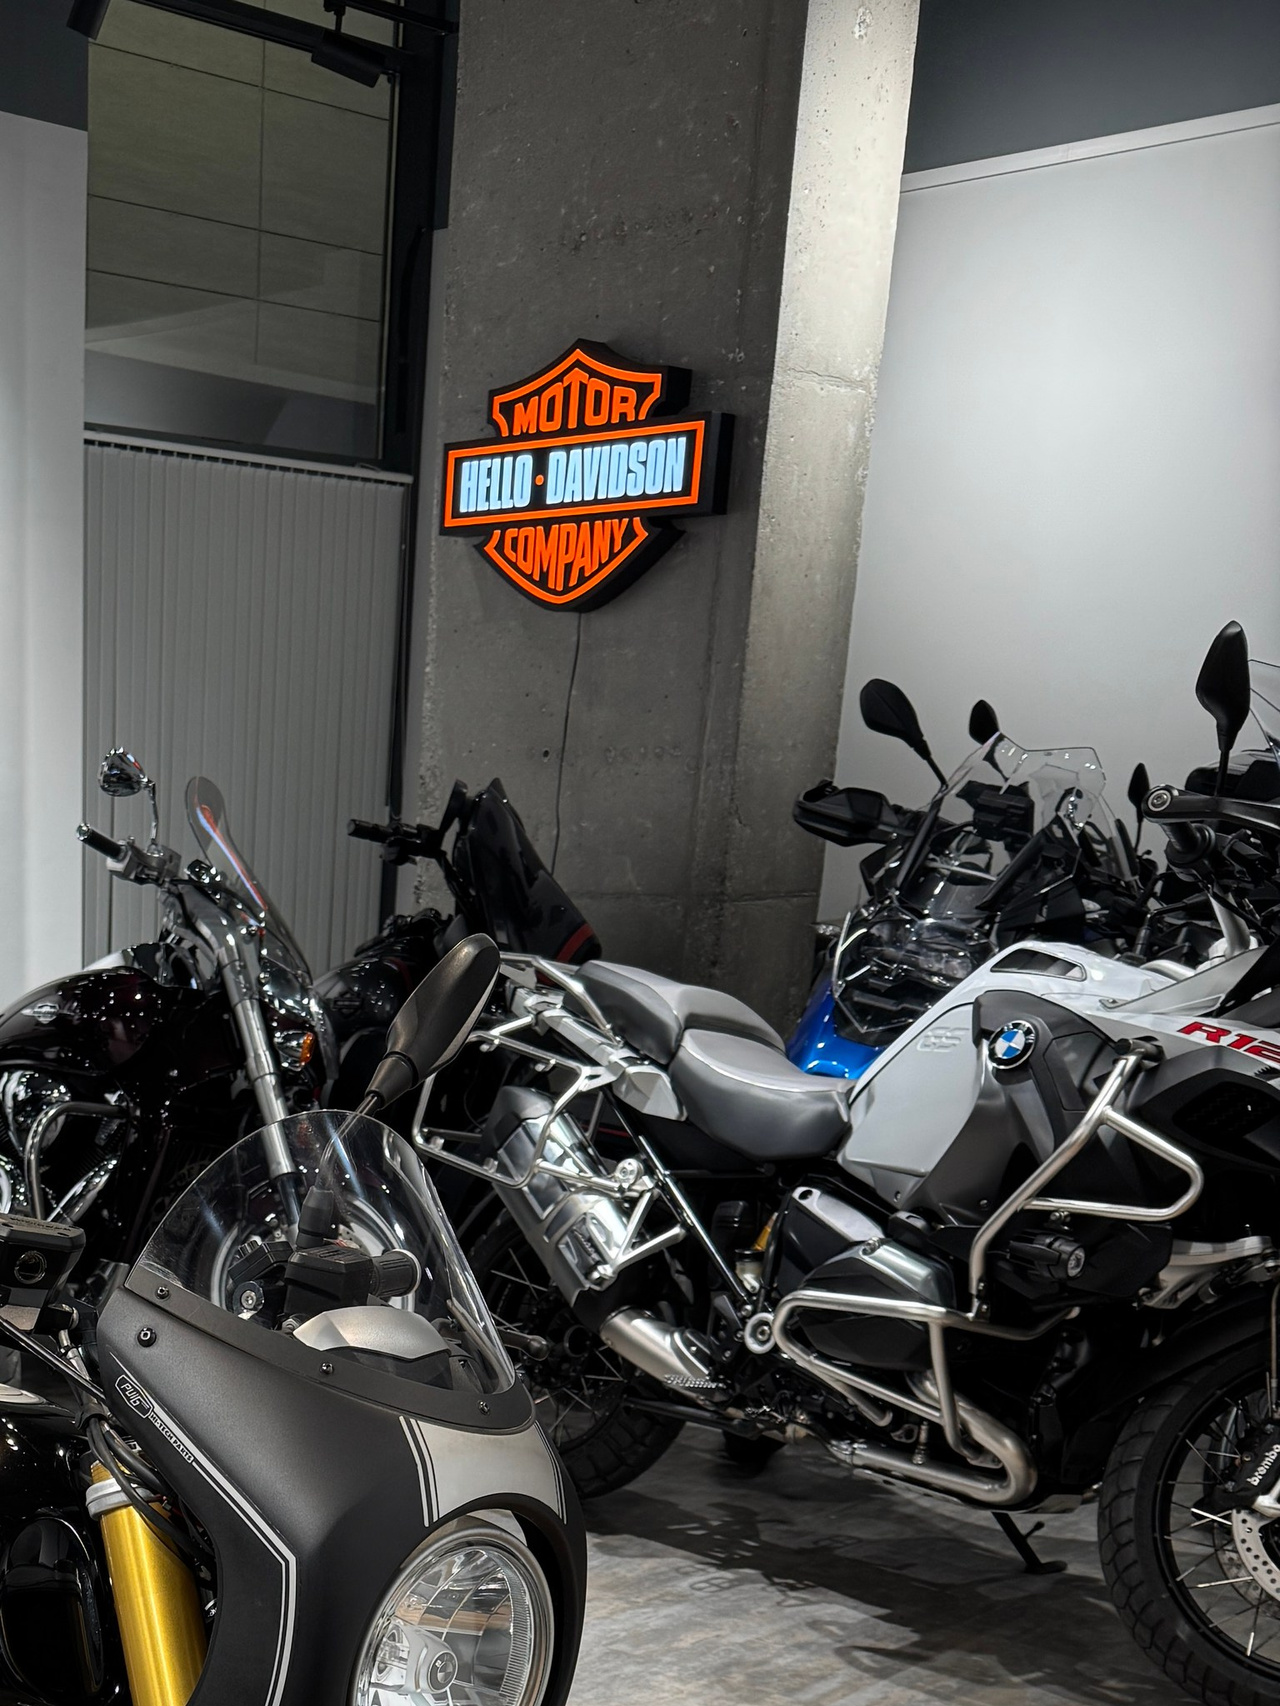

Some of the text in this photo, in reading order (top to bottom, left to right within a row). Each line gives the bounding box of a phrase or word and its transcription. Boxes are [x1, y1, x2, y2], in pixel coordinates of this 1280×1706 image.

[512, 367, 638, 437] MOTOR
[458, 437, 688, 513] HELLO DAVIDSON
[504, 517, 630, 592] COMPANY
[120, 1383, 148, 1408] PUIG
[173, 1439, 193, 1462] PARTS
